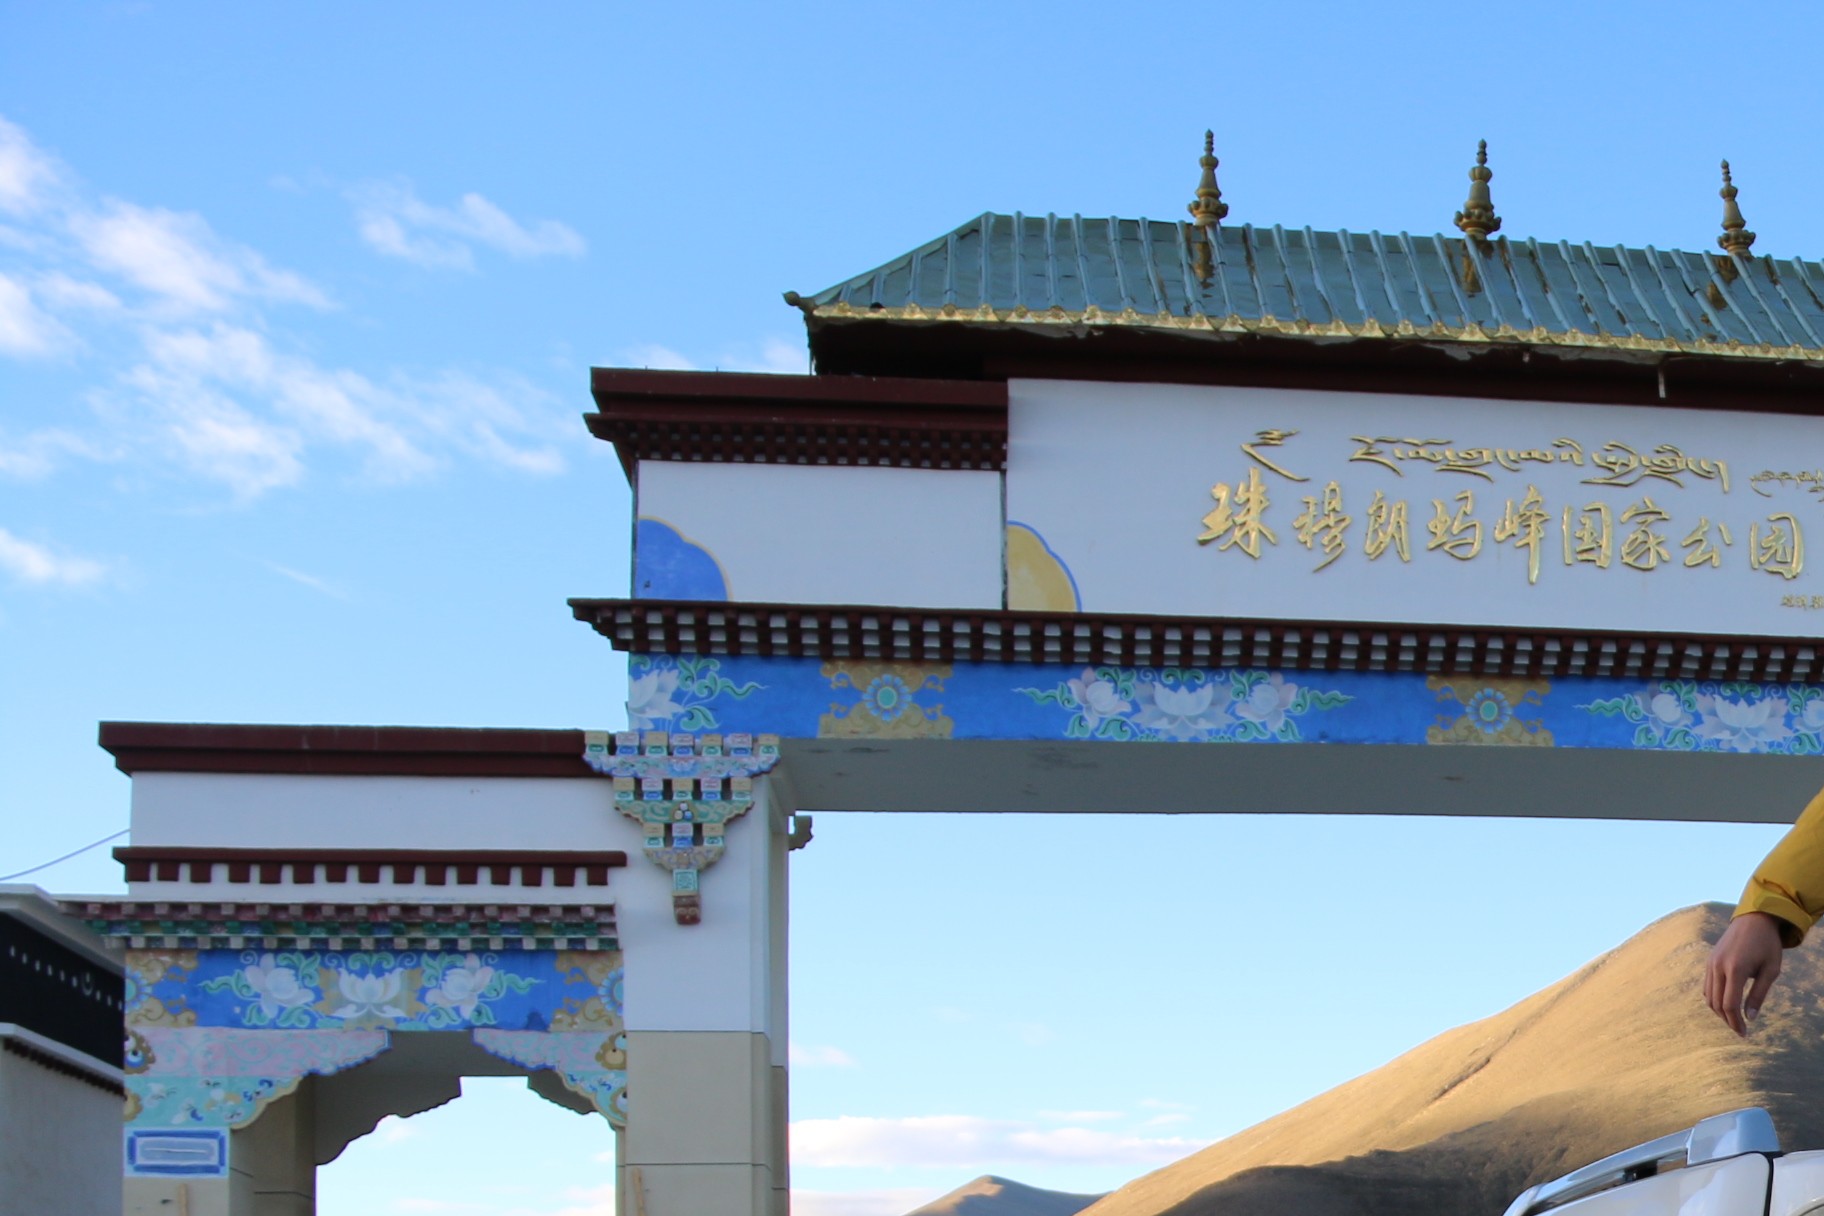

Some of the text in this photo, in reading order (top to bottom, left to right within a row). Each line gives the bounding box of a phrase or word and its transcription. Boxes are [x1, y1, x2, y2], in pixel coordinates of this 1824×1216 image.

[1197, 467, 1804, 584] 珠穆朗玛峰国家公园
